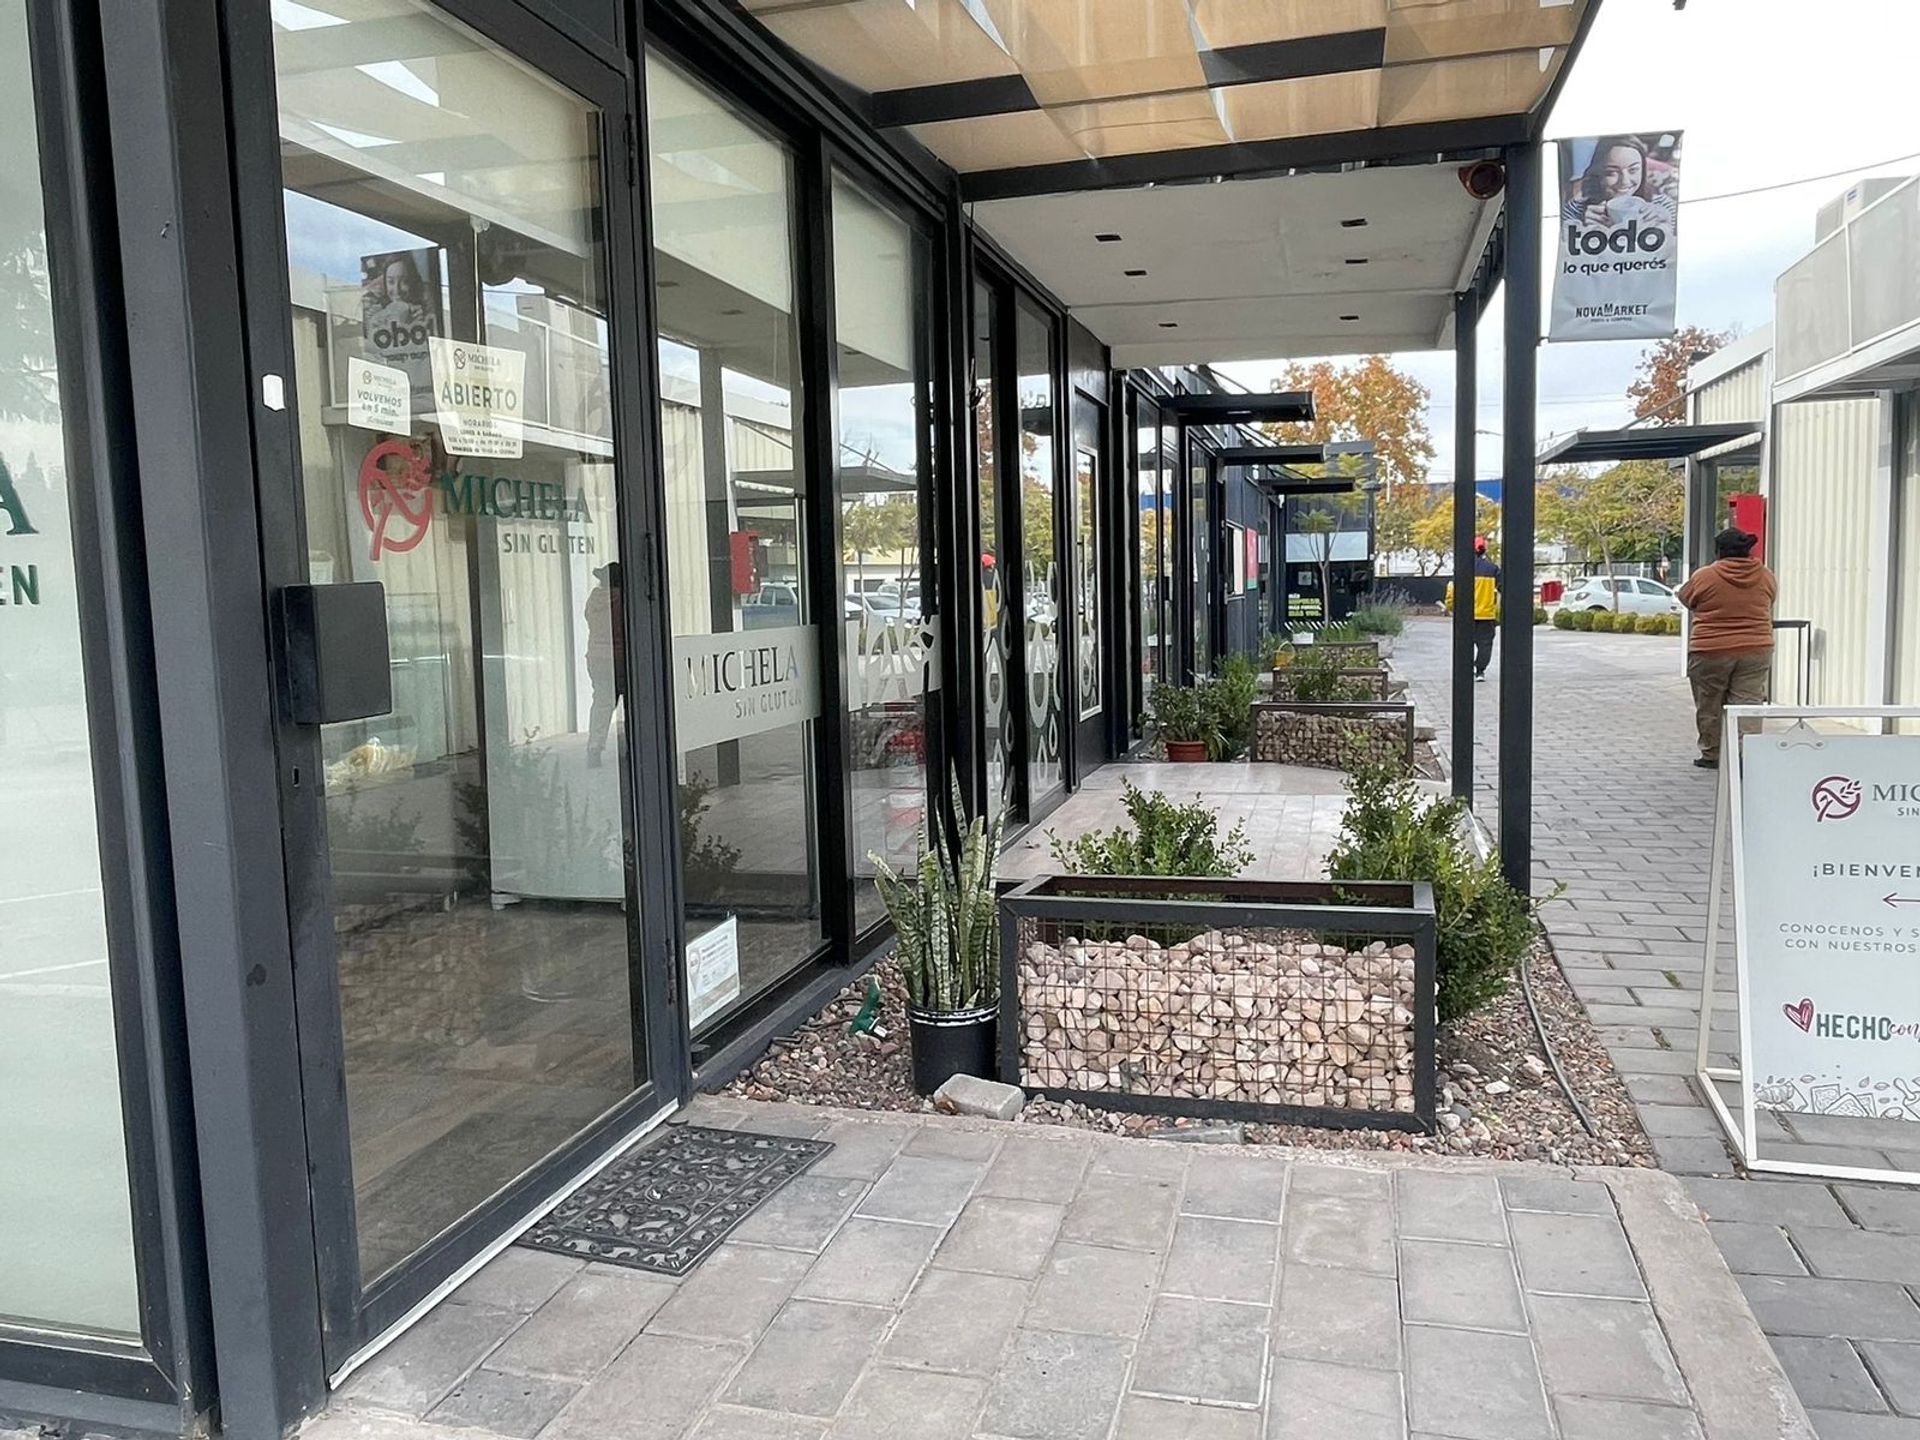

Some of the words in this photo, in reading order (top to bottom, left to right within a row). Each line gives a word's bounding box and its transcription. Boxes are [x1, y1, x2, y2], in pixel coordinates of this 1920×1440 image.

[1568, 220, 1665, 256] todo
[1563, 262, 1577, 274] lo
[1580, 263, 1609, 276] que
[1613, 257, 1666, 274] querés
[1576, 303, 1648, 318] NOVAMARKET
[357, 389, 402, 407] VOLVEMOS
[441, 381, 517, 411] ABIERTO
[440, 472, 593, 523] MICHELA
[503, 533, 531, 553] SIN
[539, 535, 595, 554] GLTEN
[0, 565, 40, 605] N
[684, 645, 800, 699] MICHELA
[735, 698, 756, 718] SIN
[1897, 806, 1920, 817] SIN
[1779, 922, 1885, 937] CONOCENOS
[1893, 927, 1903, 937] Y
[1785, 938, 1818, 949] CON
[1828, 940, 1917, 953] NUESTROS
[1816, 1013, 1892, 1041] HECHO
